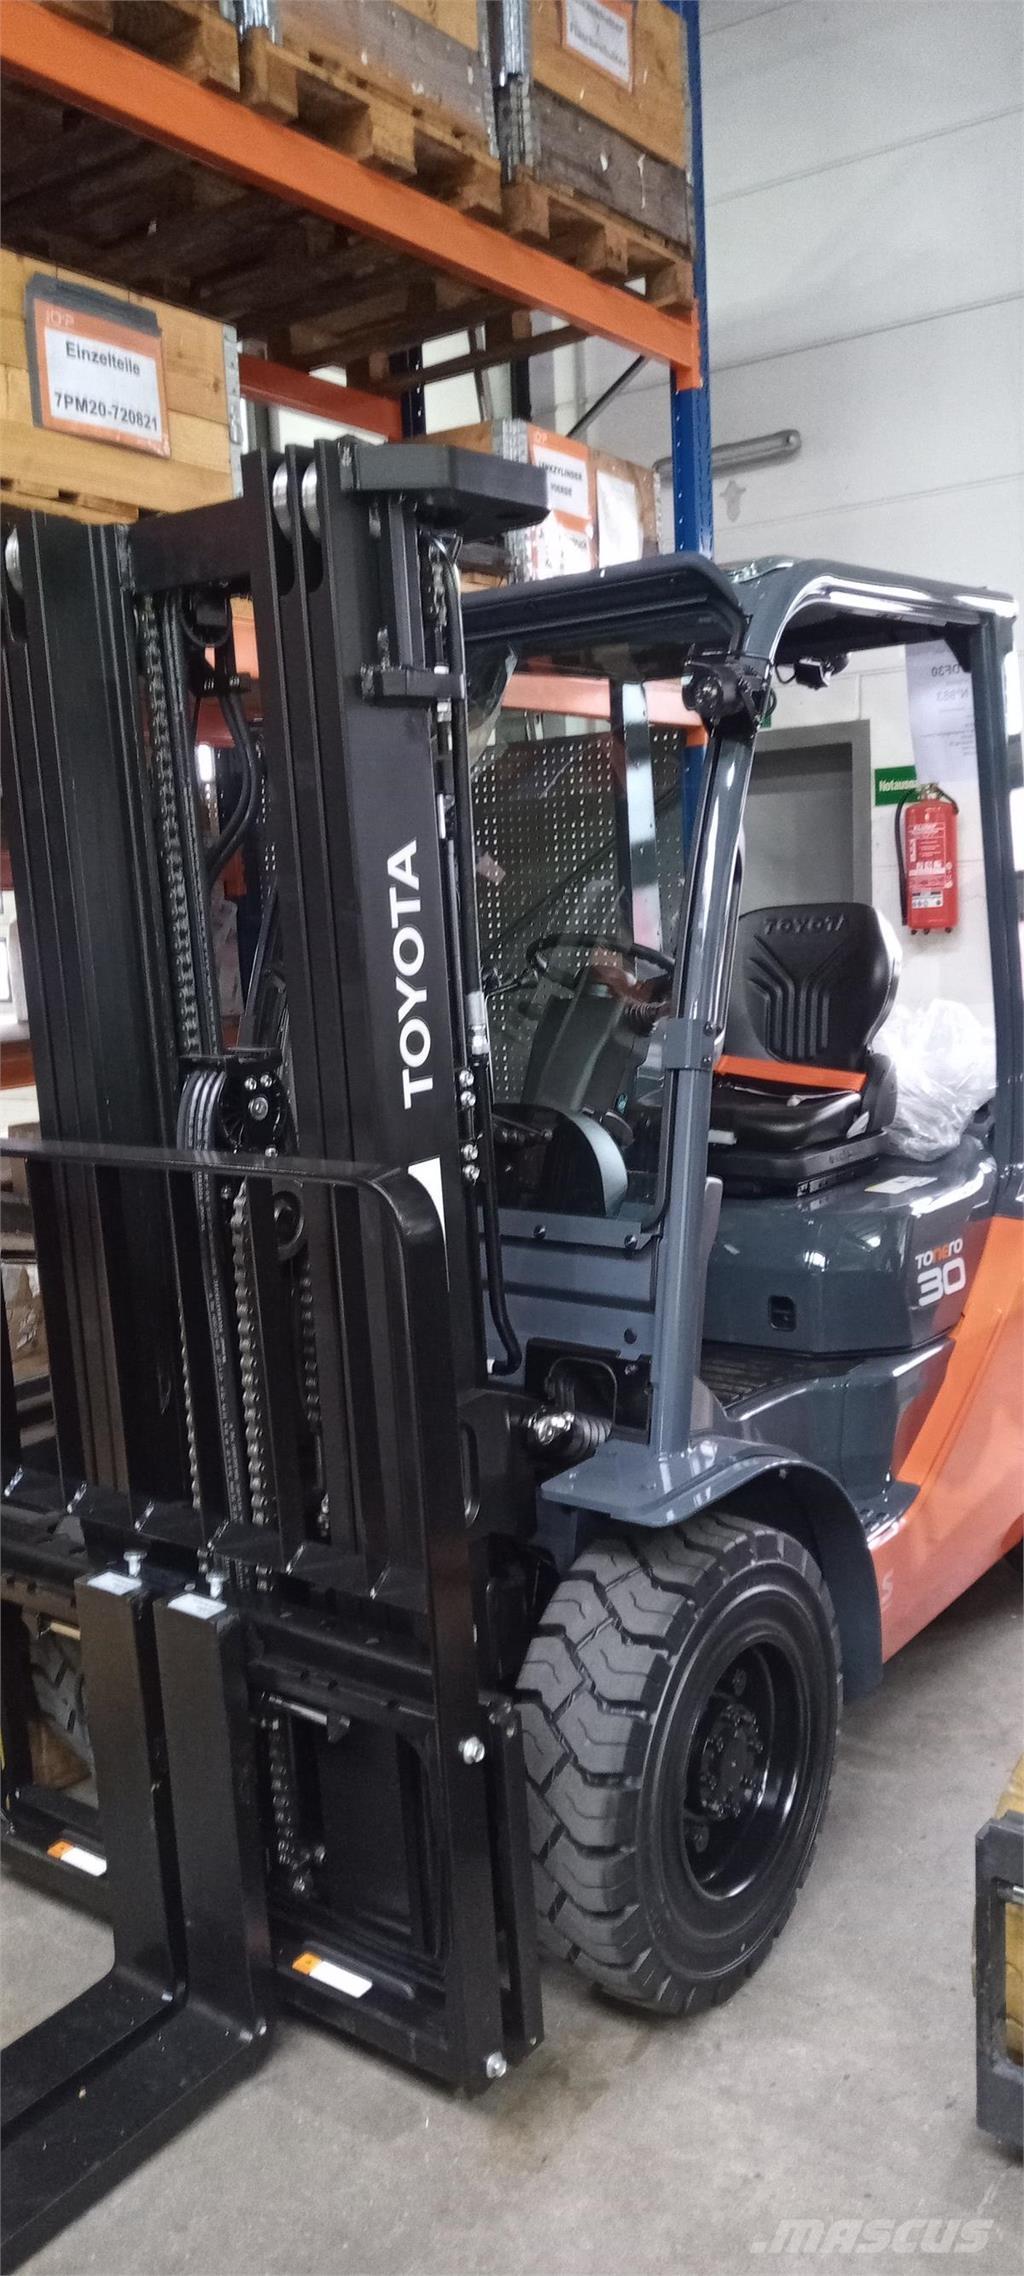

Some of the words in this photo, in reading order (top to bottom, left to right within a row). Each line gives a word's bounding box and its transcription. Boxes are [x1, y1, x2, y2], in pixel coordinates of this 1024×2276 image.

[65, 341, 140, 375] Einzelteile
[54, 391, 158, 432] 7PM20-720821
[764, 914, 844, 934] TOYOTA
[387, 839, 433, 1109] TOYOTA
[917, 1257, 966, 1306] 30
